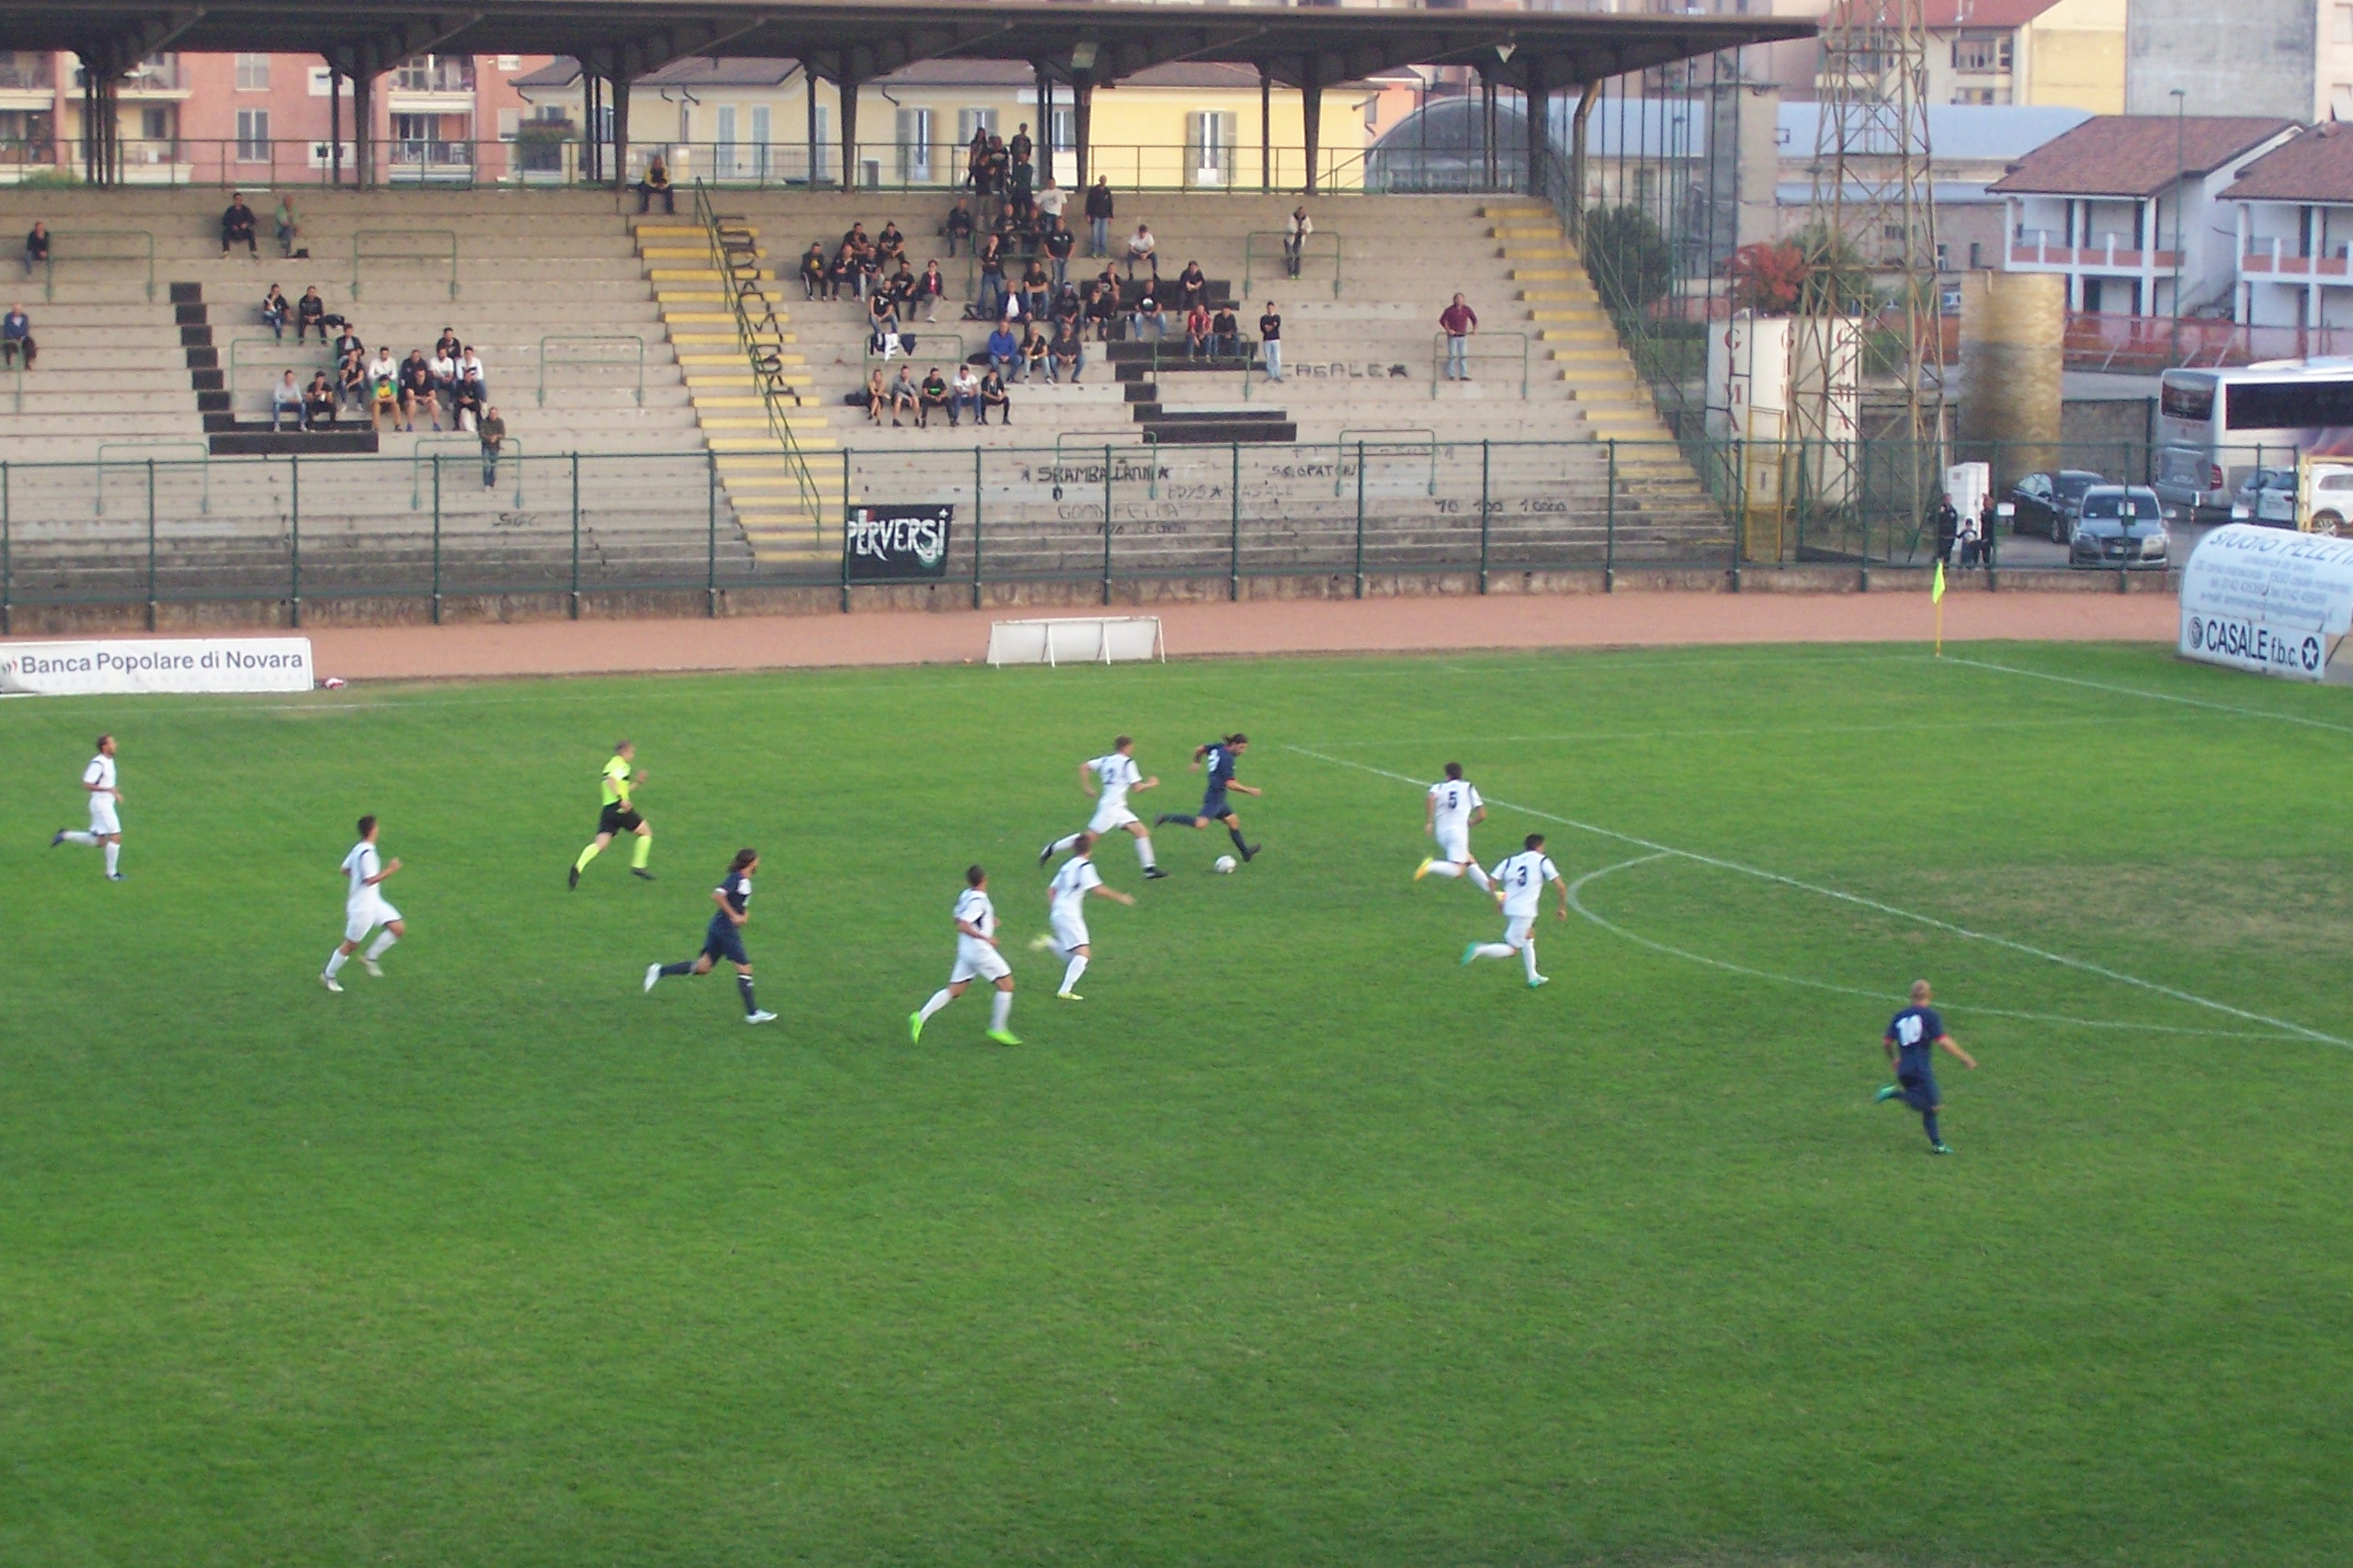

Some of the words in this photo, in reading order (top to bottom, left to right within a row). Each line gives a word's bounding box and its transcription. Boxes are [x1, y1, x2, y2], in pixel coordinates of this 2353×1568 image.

[2206, 619, 2268, 662] CASALE
[2270, 636, 2299, 668] f.b.c.
[21, 655, 92, 675] Banca
[97, 651, 195, 675] Popolare
[200, 650, 221, 669] di
[226, 650, 304, 670] Novara
[1448, 790, 1458, 809] 5
[1517, 866, 1528, 886] 3
